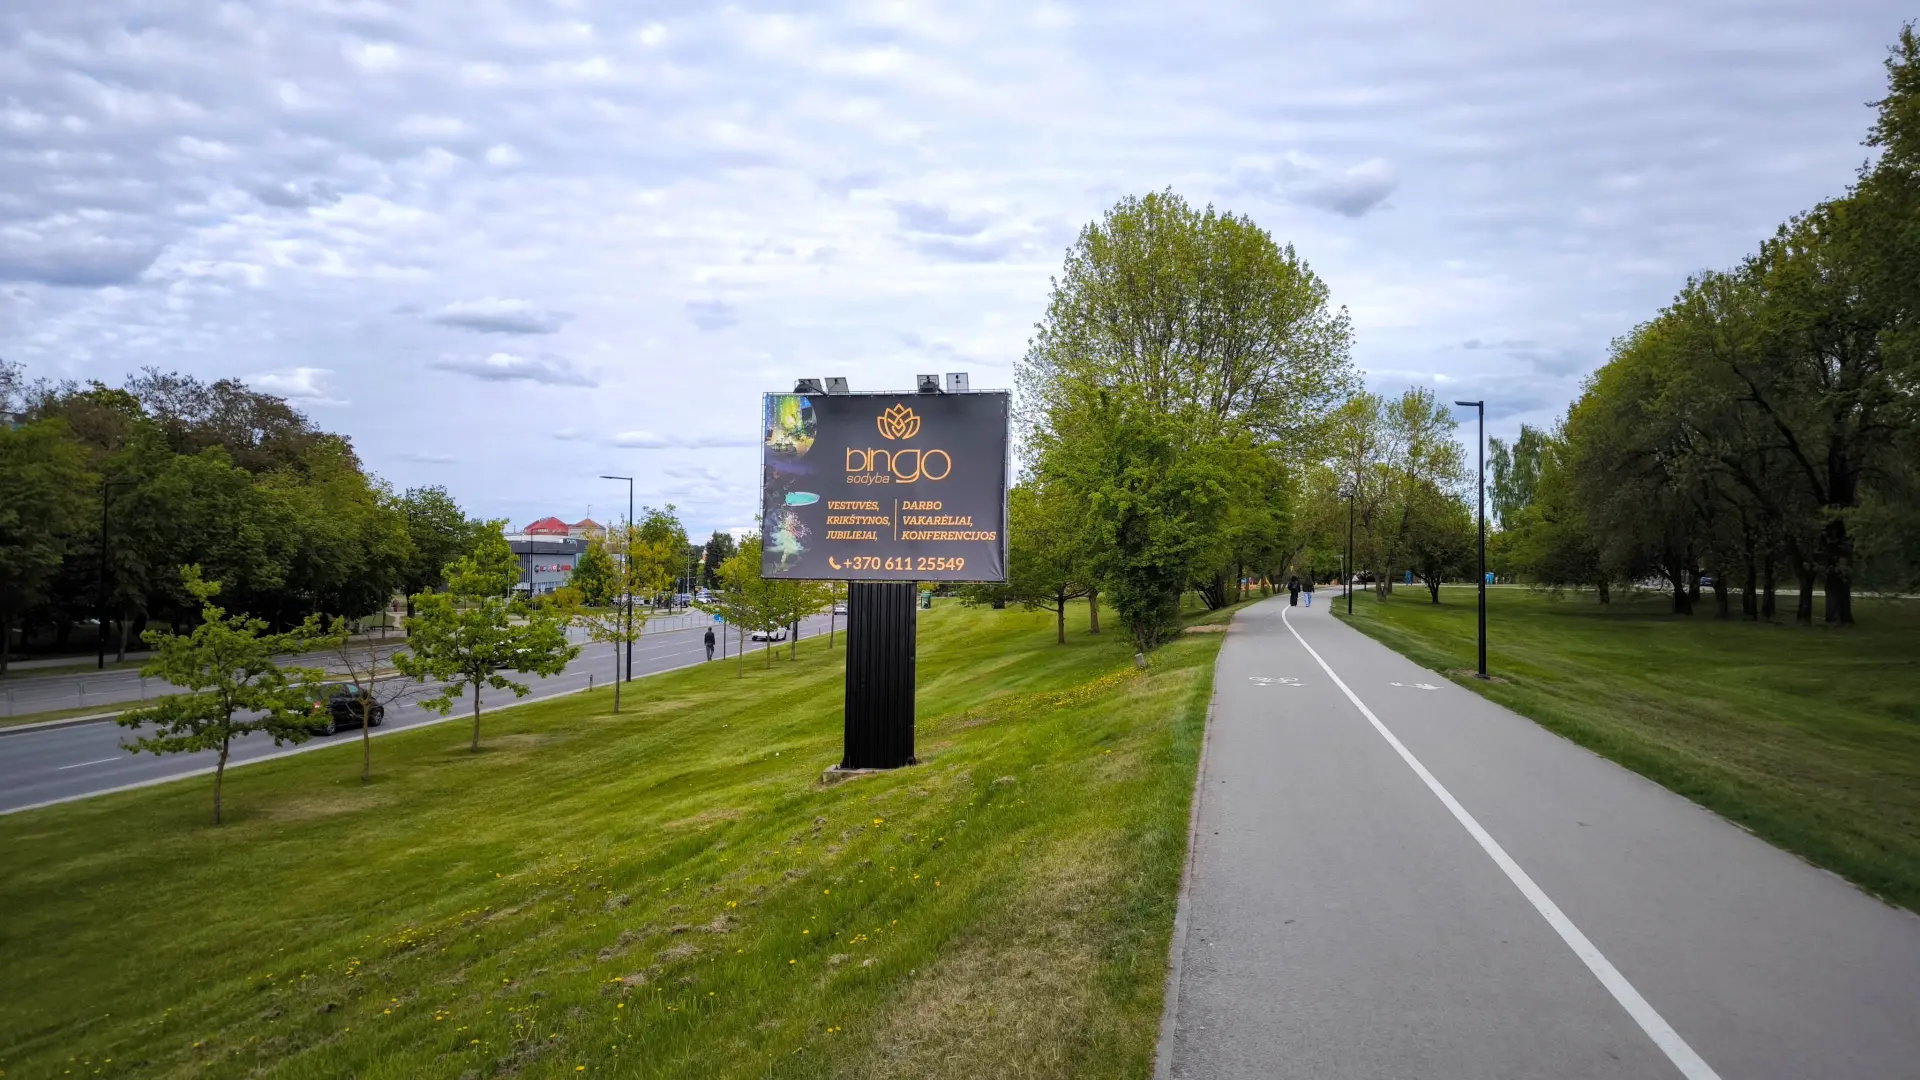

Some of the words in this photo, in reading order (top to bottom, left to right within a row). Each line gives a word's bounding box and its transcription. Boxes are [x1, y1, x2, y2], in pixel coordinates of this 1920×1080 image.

[846, 447, 951, 483] bingo
[846, 473, 890, 485] sodyba
[827, 500, 880, 511] VESTUVĖS,
[902, 501, 942, 510] DARBO
[826, 514, 891, 526] KRIKŠTYNOS,
[902, 514, 973, 526] VAKARĖLIAI,
[826, 531, 878, 541] JUBILIEJAI,
[901, 531, 997, 541] KONFERENCIJOS
[843, 556, 881, 570] +370
[884, 557, 912, 571] 611
[917, 557, 965, 571] 25549
